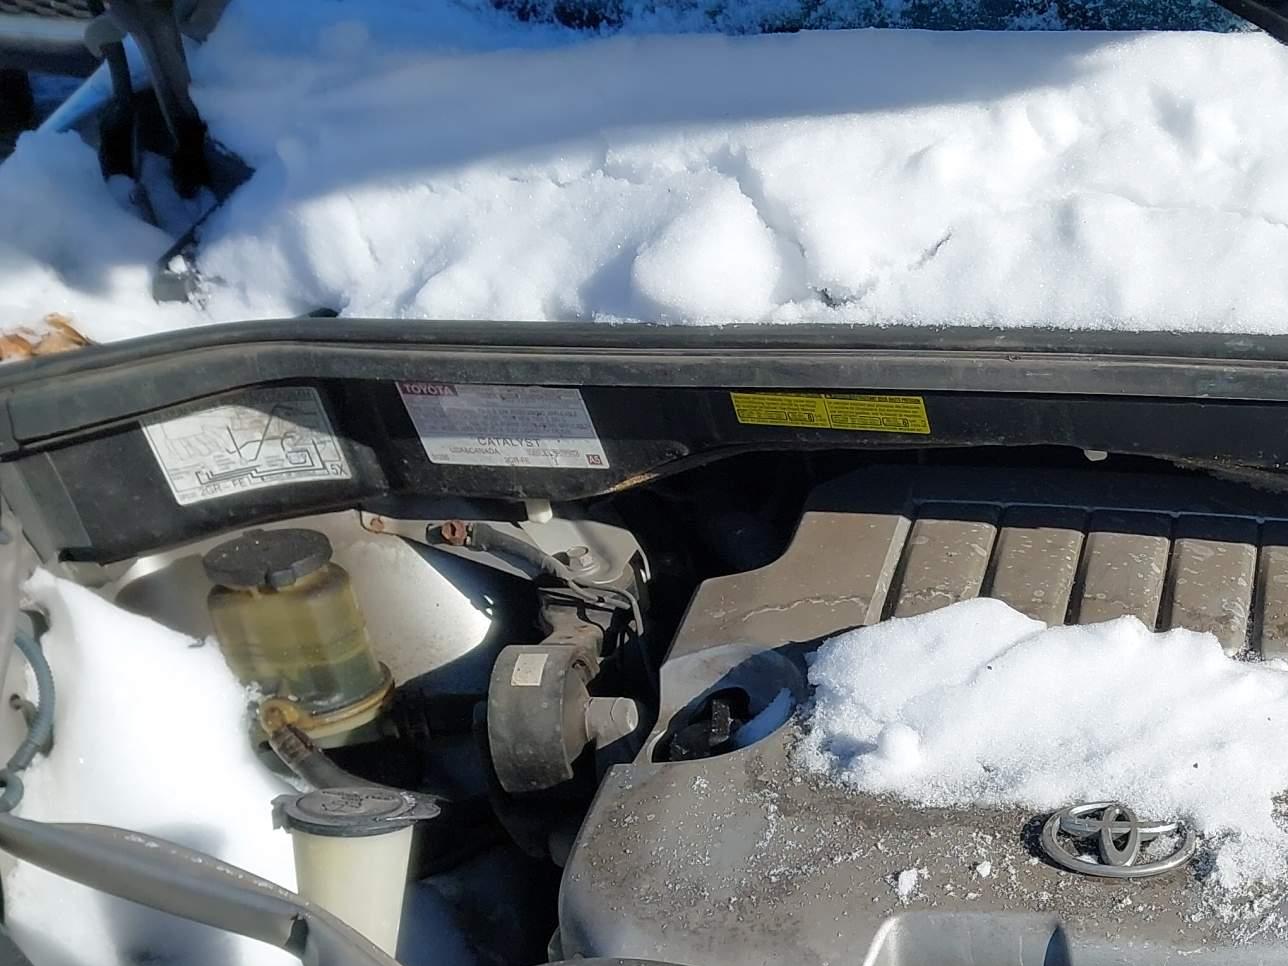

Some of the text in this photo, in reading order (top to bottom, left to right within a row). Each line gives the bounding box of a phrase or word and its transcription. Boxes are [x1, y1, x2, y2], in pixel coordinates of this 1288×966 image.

[403, 384, 451, 395] TOYOTA
[477, 436, 541, 448] CATALYST
[329, 463, 346, 477] 5X
